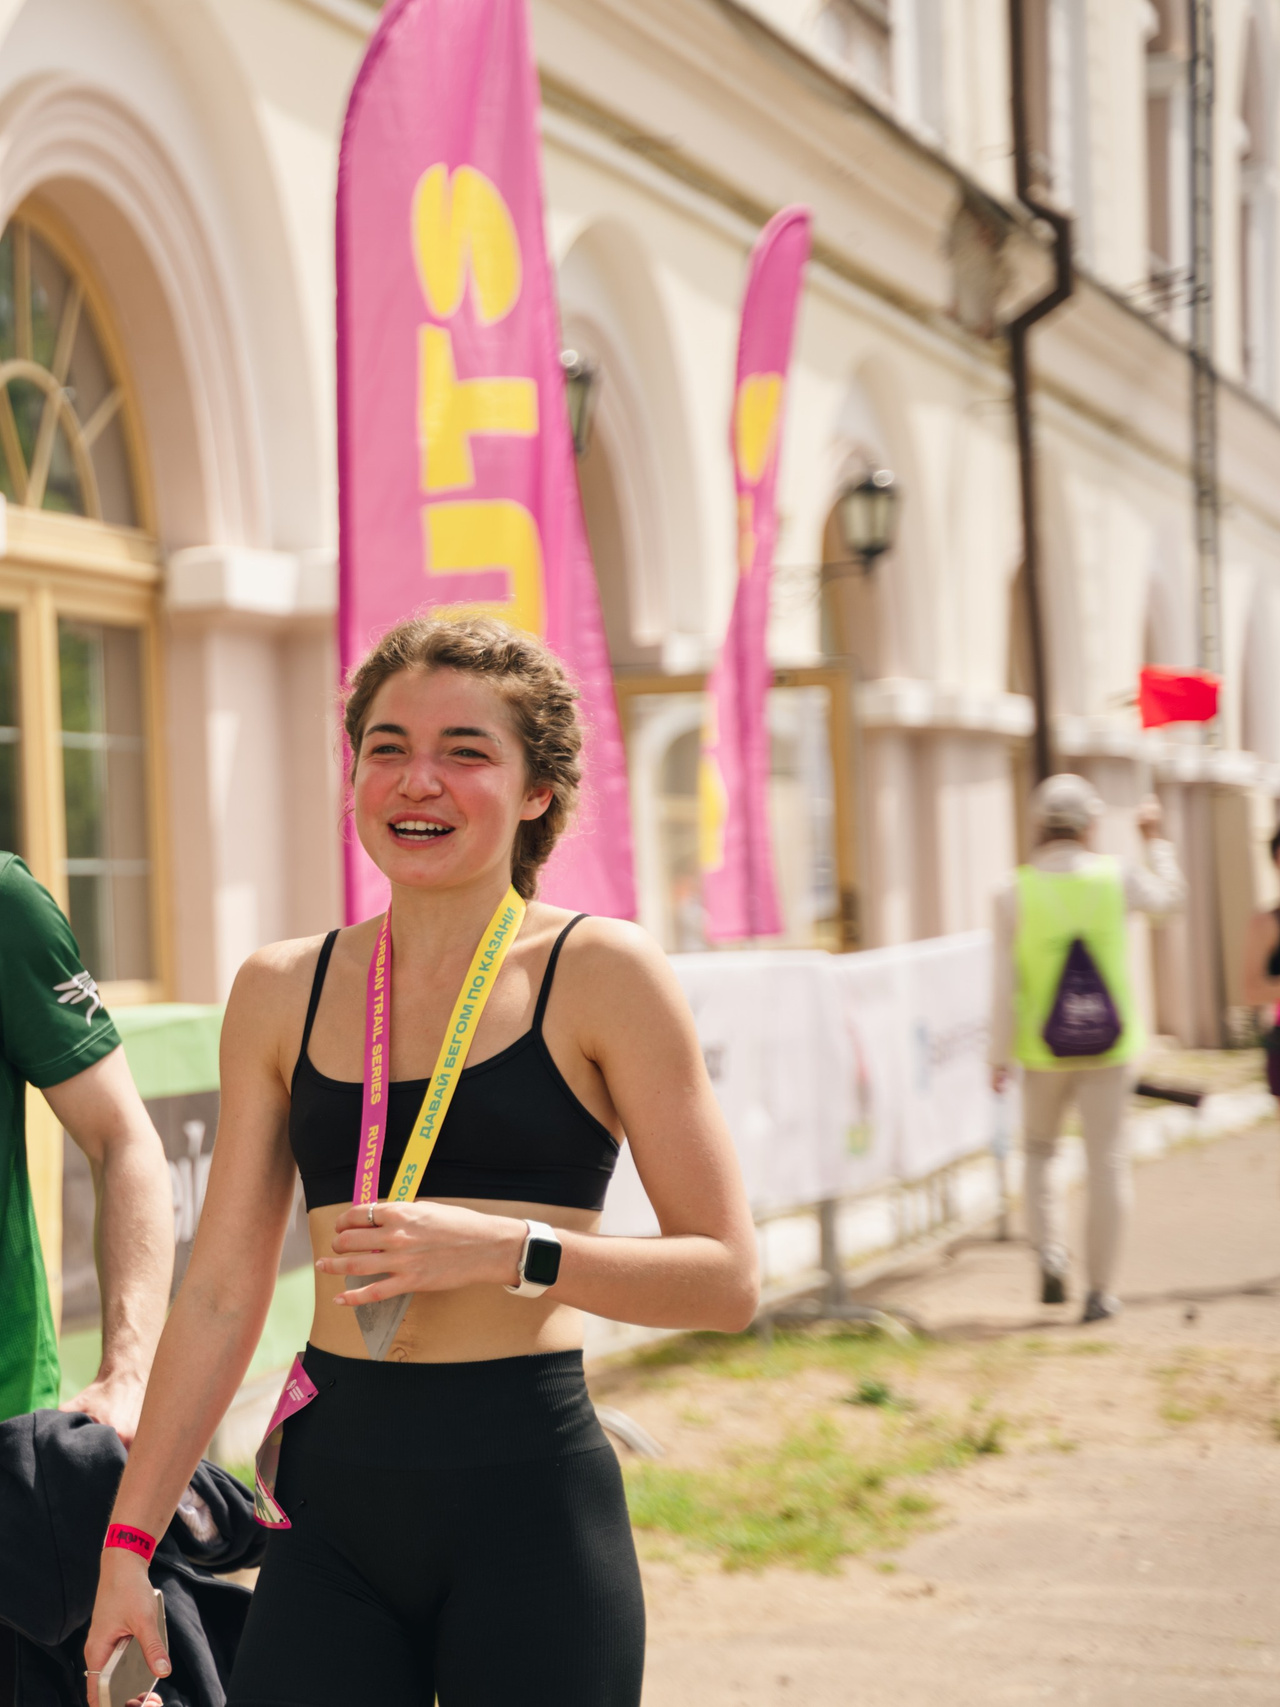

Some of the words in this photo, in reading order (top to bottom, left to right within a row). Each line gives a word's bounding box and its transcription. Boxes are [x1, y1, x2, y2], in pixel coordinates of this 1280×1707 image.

[412, 162, 546, 635] UTS
[373, 932, 387, 991] URBAN
[372, 991, 384, 1043] TRAIL
[419, 1072, 452, 1140] ДАВАЙ
[443, 1003, 476, 1069] БЕГОМ
[467, 975, 486, 1000] ПО
[478, 906, 518, 972] КАЗАНИ
[370, 1043, 383, 1106] SERIES
[363, 1125, 380, 1170] RUTS
